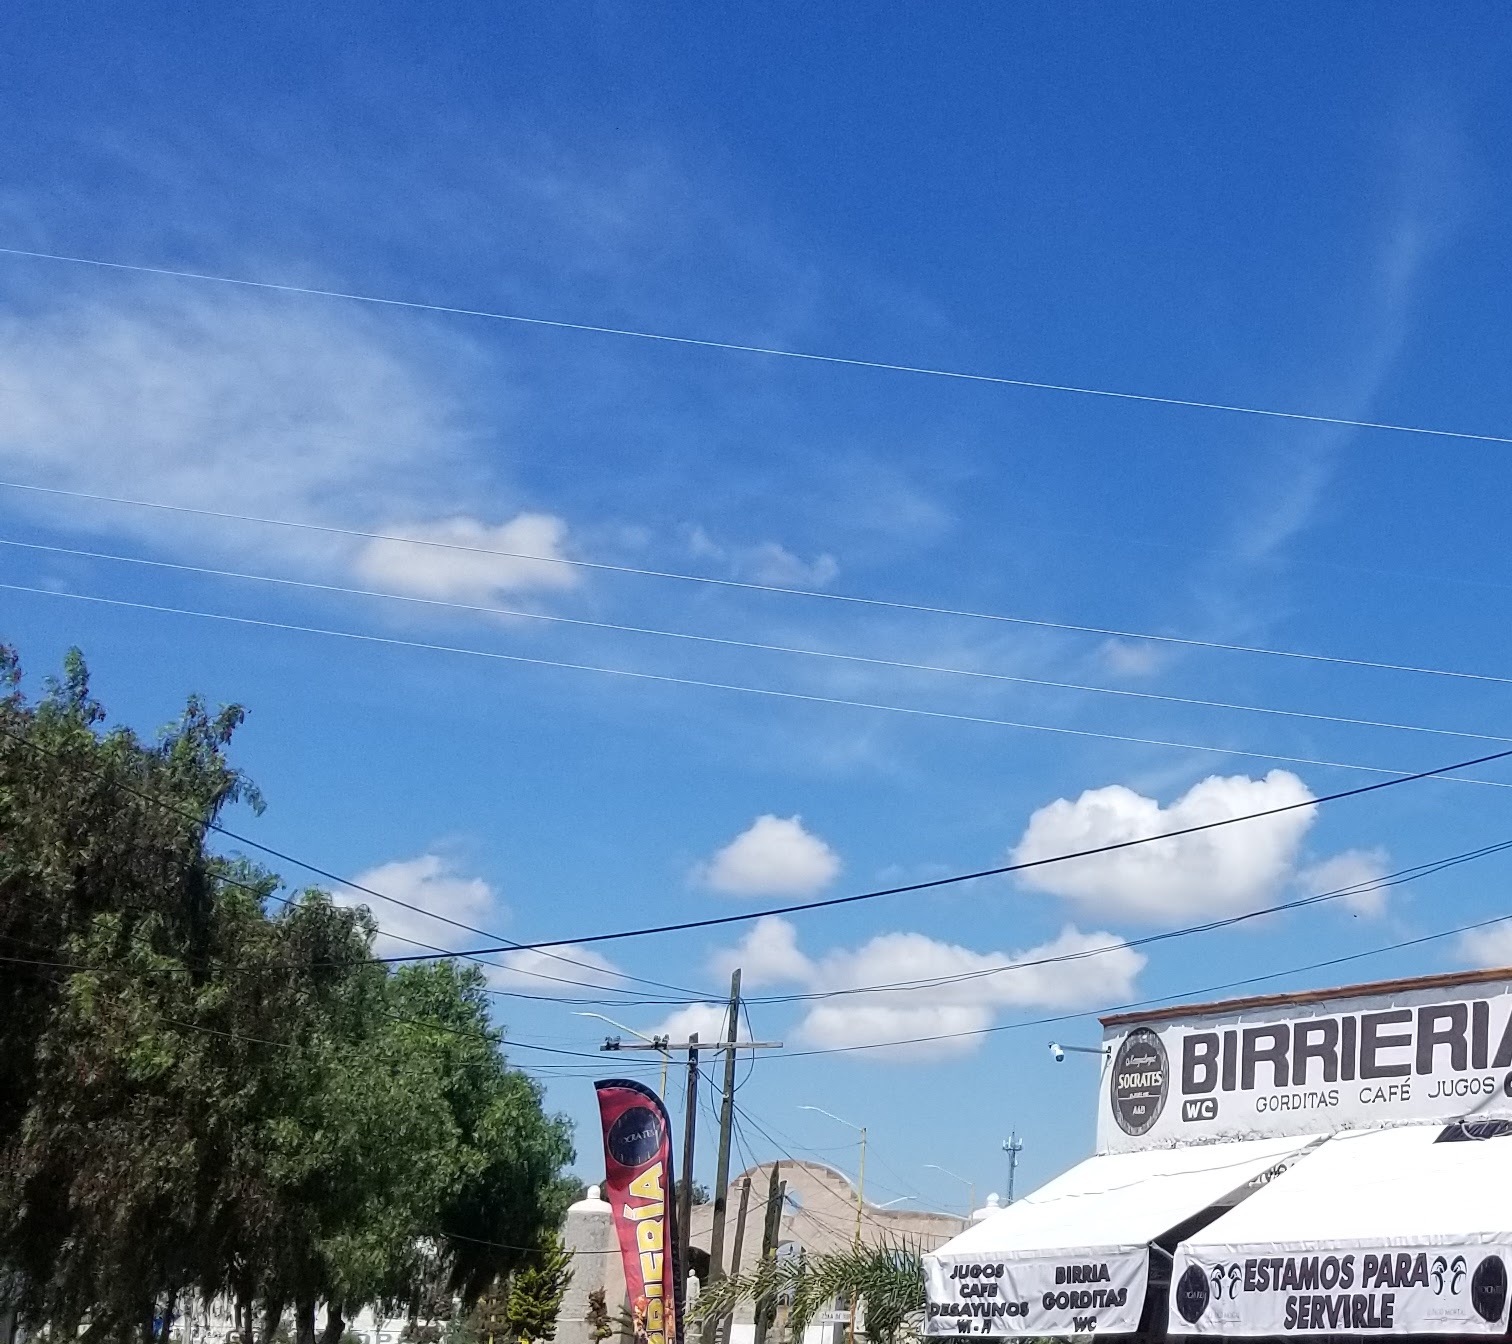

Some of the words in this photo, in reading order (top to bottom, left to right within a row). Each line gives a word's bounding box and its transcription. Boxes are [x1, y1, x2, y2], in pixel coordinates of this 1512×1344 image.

[1118, 1070, 1162, 1089] SOCRATES
[1255, 1090, 1340, 1113] GORDITAS
[1359, 1079, 1411, 1105] CAFÉ
[1428, 1076, 1496, 1098] JUGOS
[1185, 1100, 1215, 1120] WC
[950, 1263, 1004, 1279] JUGOS
[1055, 1264, 1110, 1284] BIRRIA
[1243, 1255, 1355, 1292] ESTAMOS
[1362, 1253, 1430, 1288] PARA
[930, 1301, 1030, 1317] DESAYUNOS
[1042, 1288, 1128, 1310] GORDITAS
[1284, 1293, 1395, 1330] SERVIRLE
[1073, 1316, 1097, 1333] WC
